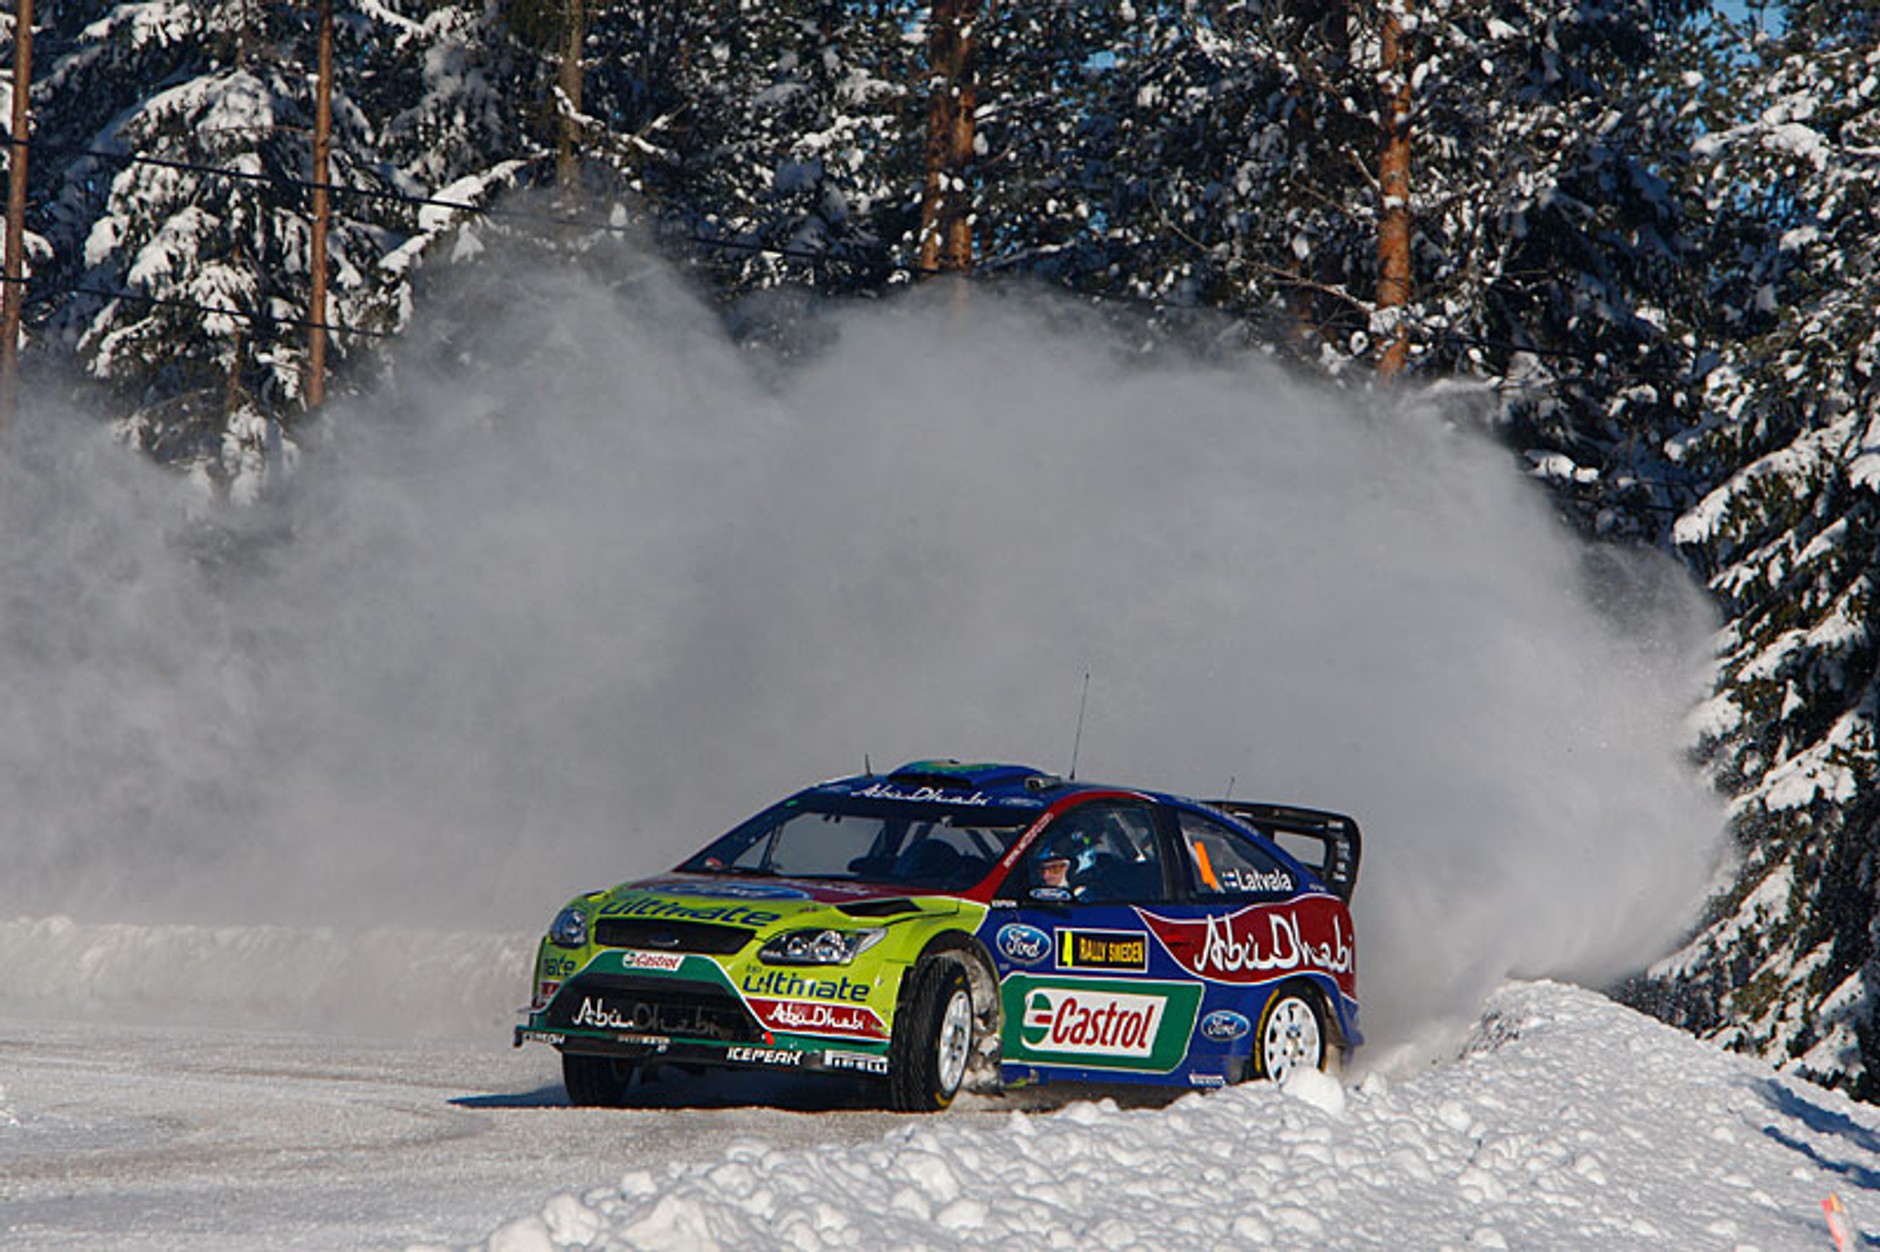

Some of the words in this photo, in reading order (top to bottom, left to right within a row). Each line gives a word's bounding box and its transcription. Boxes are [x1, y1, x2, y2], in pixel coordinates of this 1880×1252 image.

[1236, 868, 1294, 891] Latvala
[600, 900, 782, 927] ultimate
[1006, 926, 1041, 957] Ford
[1079, 938, 1108, 961] RALLY
[1109, 941, 1144, 964] SWEDEN
[1194, 913, 1269, 972] Abu
[1269, 911, 1354, 973] Dhabi
[636, 954, 681, 969] Castrol
[743, 971, 871, 1001] ultimate
[571, 996, 635, 1028] Abu
[767, 1002, 813, 1027] Abu
[812, 1006, 867, 1030] Dhabi
[1053, 998, 1155, 1049] Castrol
[1208, 1016, 1238, 1036] Ford
[727, 1047, 803, 1066] ICEPEAK
